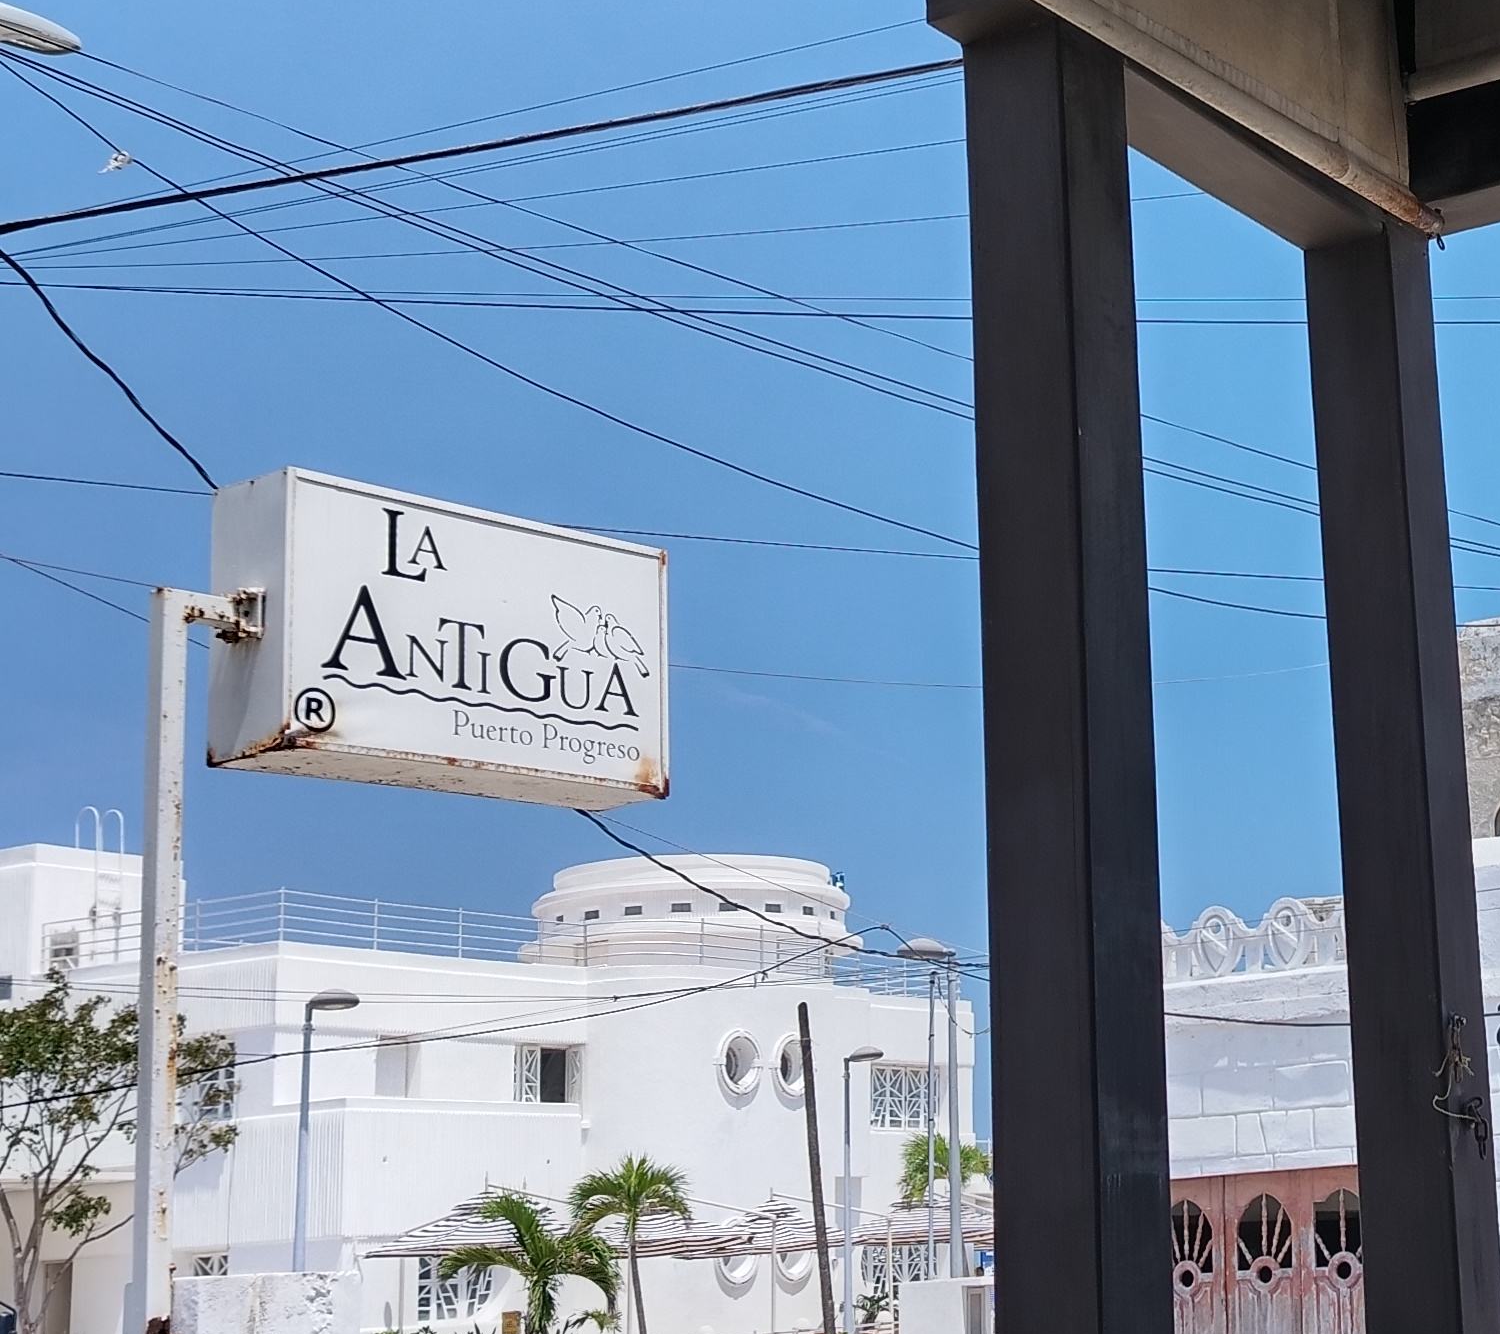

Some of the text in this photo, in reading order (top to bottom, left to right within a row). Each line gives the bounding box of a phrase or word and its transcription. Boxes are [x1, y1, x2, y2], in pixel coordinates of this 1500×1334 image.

[320, 584, 640, 718] ANTIGUA
[452, 709, 641, 765] Puerto Progreso
